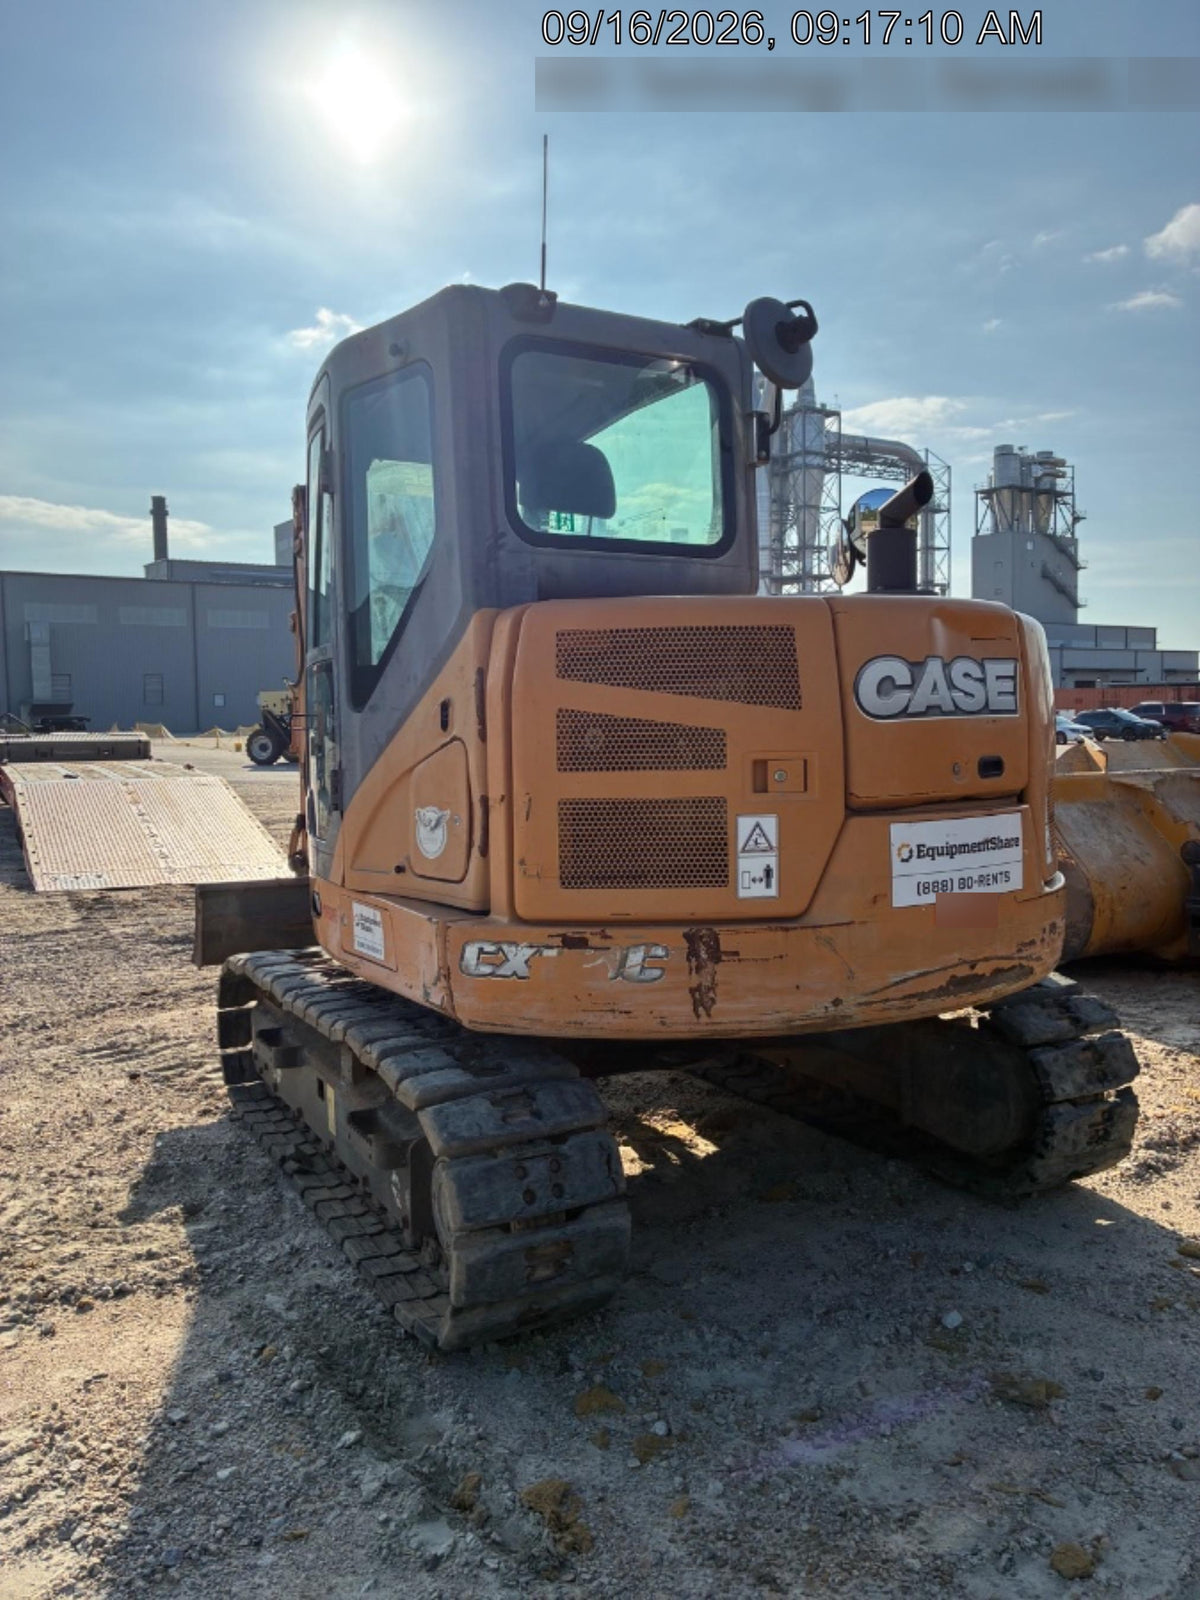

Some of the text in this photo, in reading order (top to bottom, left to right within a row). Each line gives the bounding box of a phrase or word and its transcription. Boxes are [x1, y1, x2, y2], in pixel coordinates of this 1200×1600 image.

[855, 655, 1018, 718] CASE
[915, 836, 1020, 861] EquipmentShare
[916, 878, 954, 896] (888)
